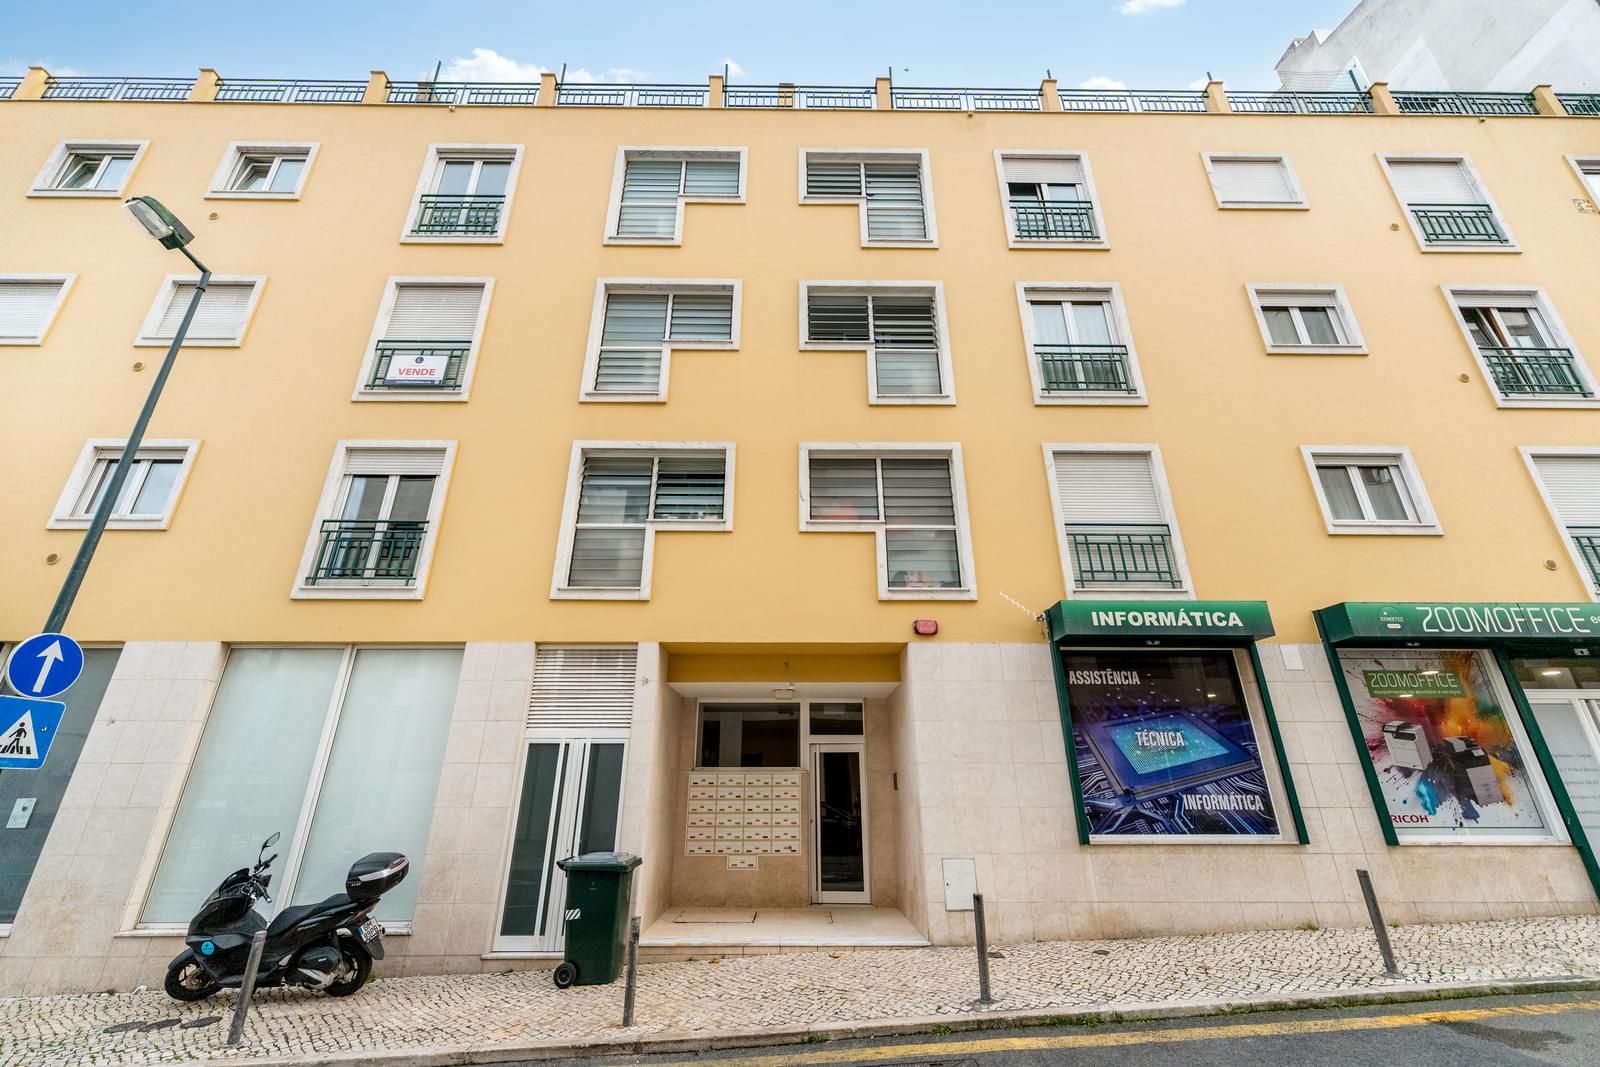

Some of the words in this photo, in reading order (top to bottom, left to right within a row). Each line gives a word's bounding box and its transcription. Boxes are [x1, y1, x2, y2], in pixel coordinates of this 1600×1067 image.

[398, 367, 436, 376] VENDE
[1091, 608, 1244, 627] INFORMÁTICA
[1416, 607, 1591, 633] ZOOMOFFICE
[1069, 668, 1141, 685] ASSISTÊNCIA
[1367, 673, 1459, 688] ZOOMOFFICE
[1135, 729, 1185, 747] TÉCNICA
[1183, 792, 1264, 811] INFORMÁTICA
[1390, 814, 1429, 823] RICOH
